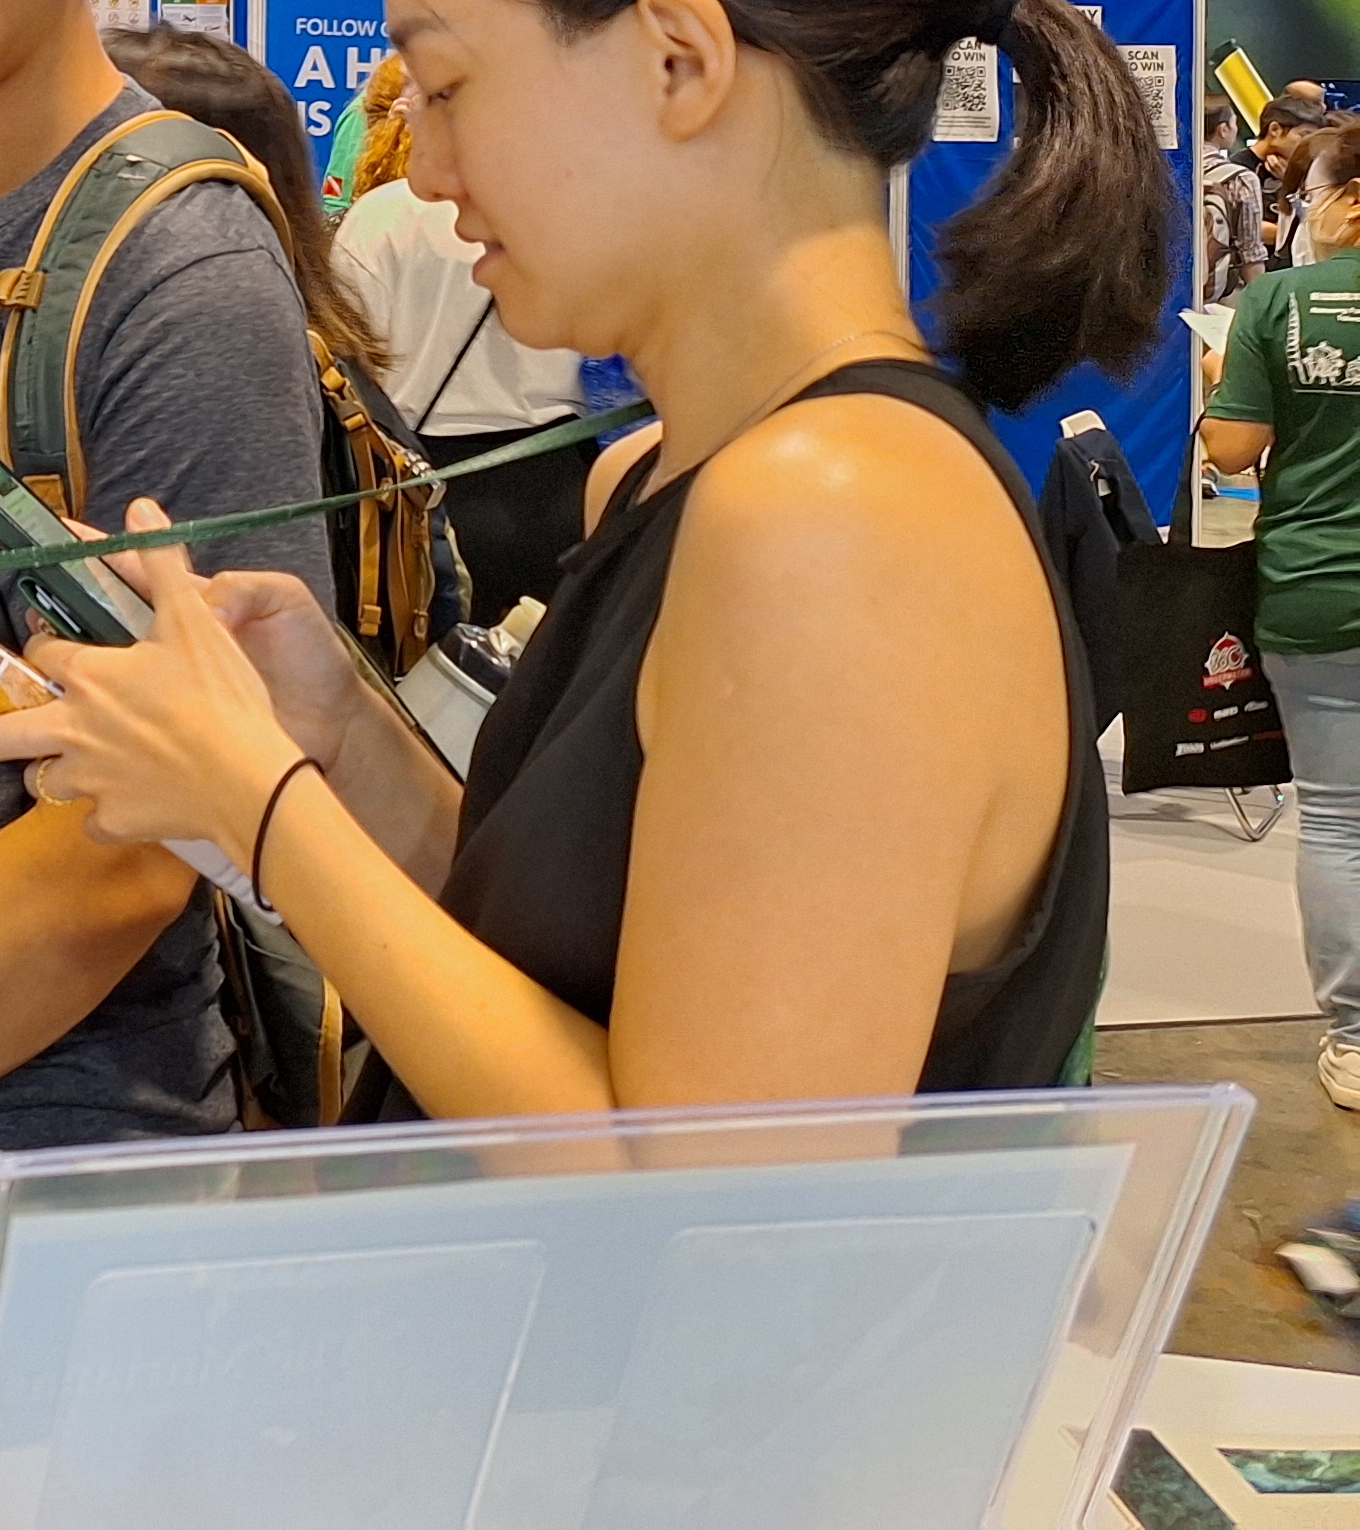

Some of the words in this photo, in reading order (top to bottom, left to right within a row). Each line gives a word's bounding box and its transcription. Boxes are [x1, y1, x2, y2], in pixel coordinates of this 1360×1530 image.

[295, 17, 378, 37] FOLLOW
[964, 52, 986, 62] WIN
[1127, 50, 1159, 61] SCAN
[293, 45, 336, 89] A
[1141, 61, 1164, 72] WIN
